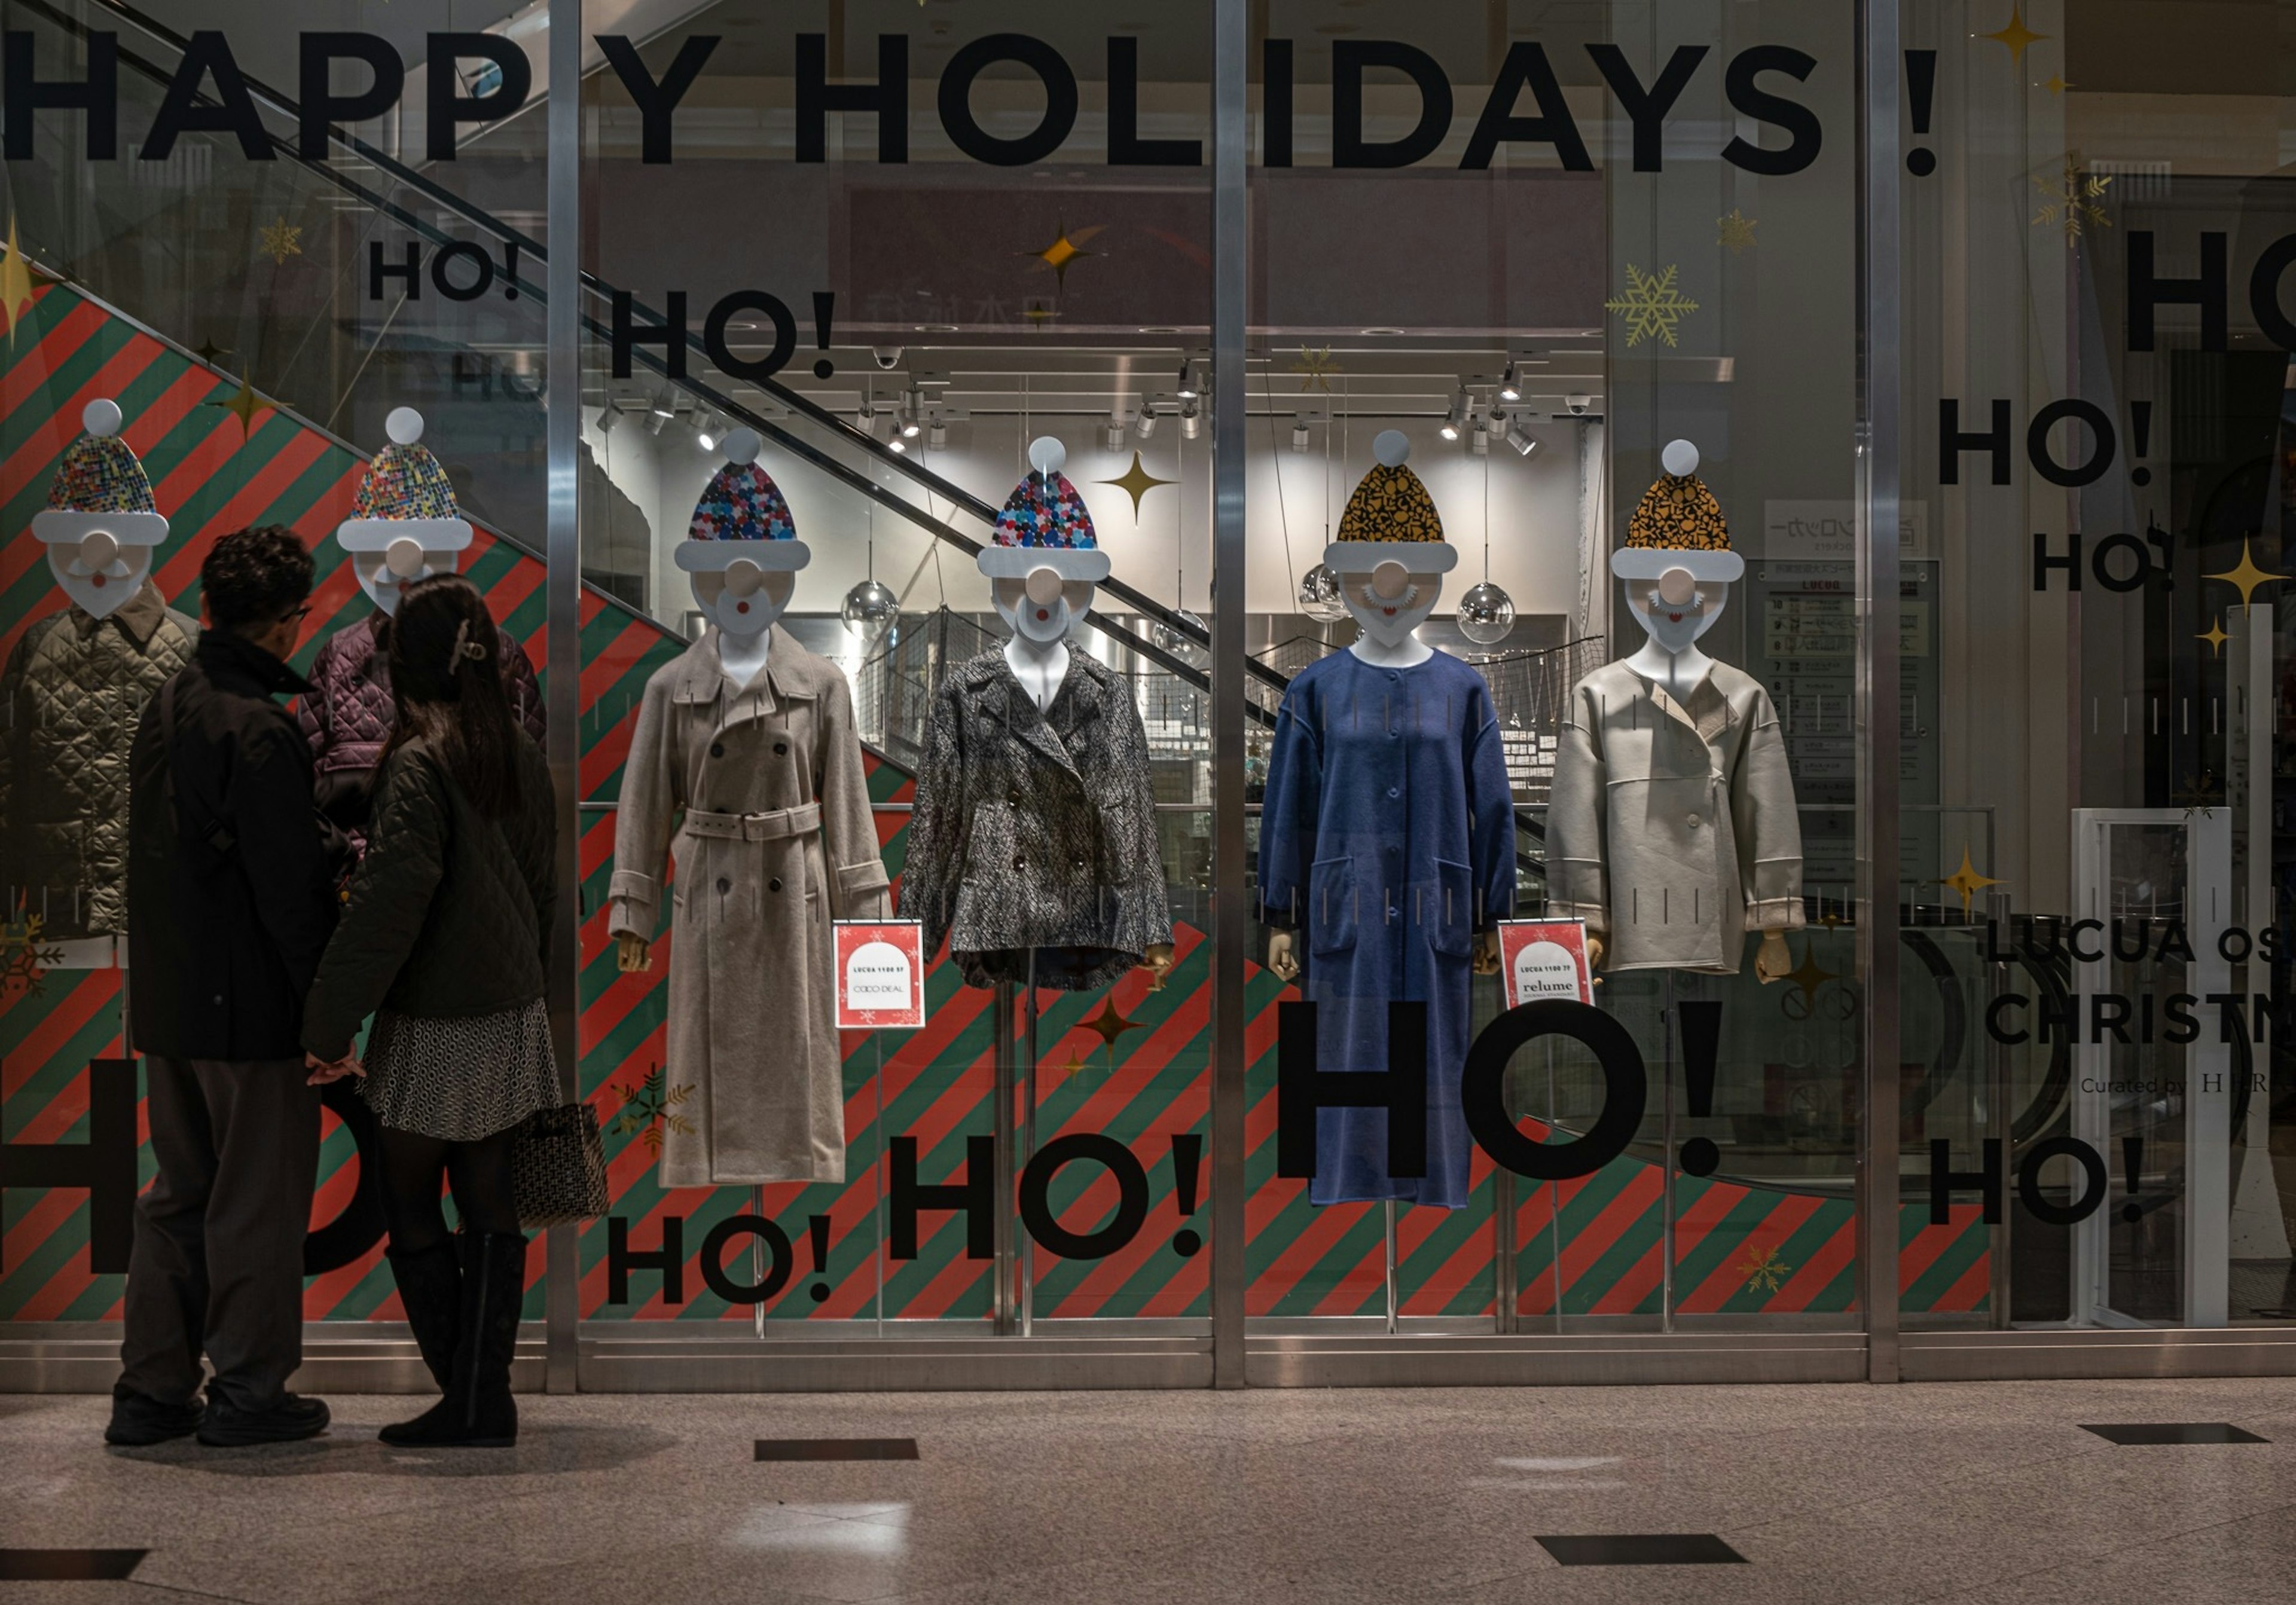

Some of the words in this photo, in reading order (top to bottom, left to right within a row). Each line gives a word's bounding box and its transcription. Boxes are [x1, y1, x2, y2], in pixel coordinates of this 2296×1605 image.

[3, 30, 722, 164] HAPPY
[370, 241, 519, 301] HO!
[612, 291, 835, 380] HO!
[1940, 399, 2151, 488] HO!
[2034, 534, 2174, 592] HO!
[1987, 918, 2195, 963] LUCUA
[1523, 980, 1574, 992] relume
[1278, 999, 1722, 1179] HO!
[2081, 1078, 2157, 1093] Curated
[2164, 1078, 2187, 1097] by
[890, 1133, 1202, 1259] HO!
[1931, 1136, 2142, 1225] HO!
[608, 1215, 831, 1304] HO!
